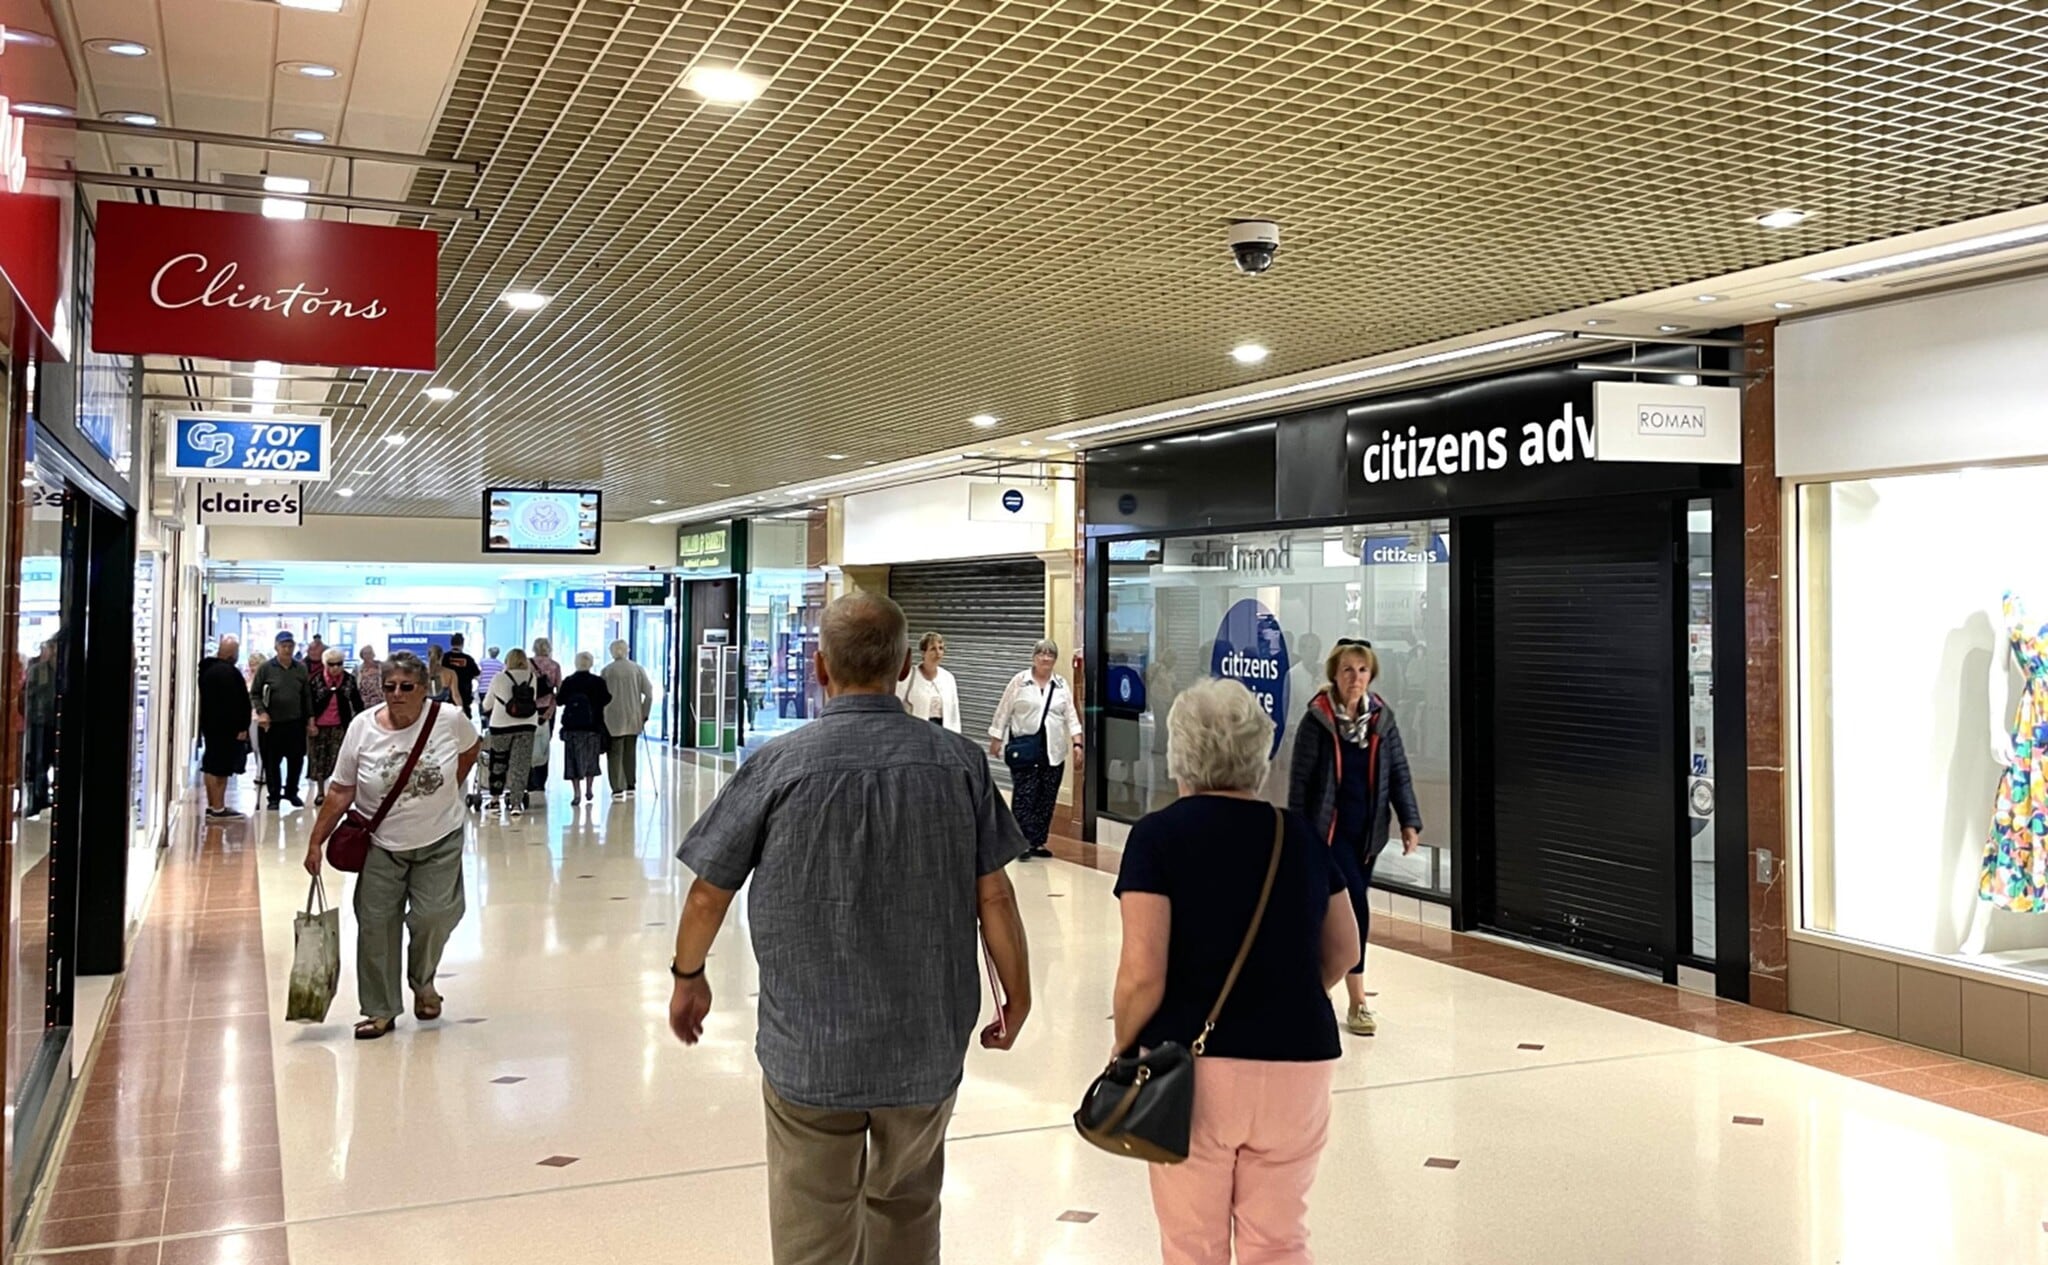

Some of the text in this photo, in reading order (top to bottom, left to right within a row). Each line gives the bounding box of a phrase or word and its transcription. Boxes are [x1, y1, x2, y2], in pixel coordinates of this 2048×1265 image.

[151, 252, 388, 319] Clintons
[1640, 411, 1703, 428] ROMAN
[250, 424, 305, 447] TOY
[1363, 401, 1595, 484] citizens adv
[242, 447, 311, 470] SHOP
[201, 492, 298, 514] claire's
[1373, 546, 1437, 562] citizens
[1221, 650, 1279, 680] citizens
